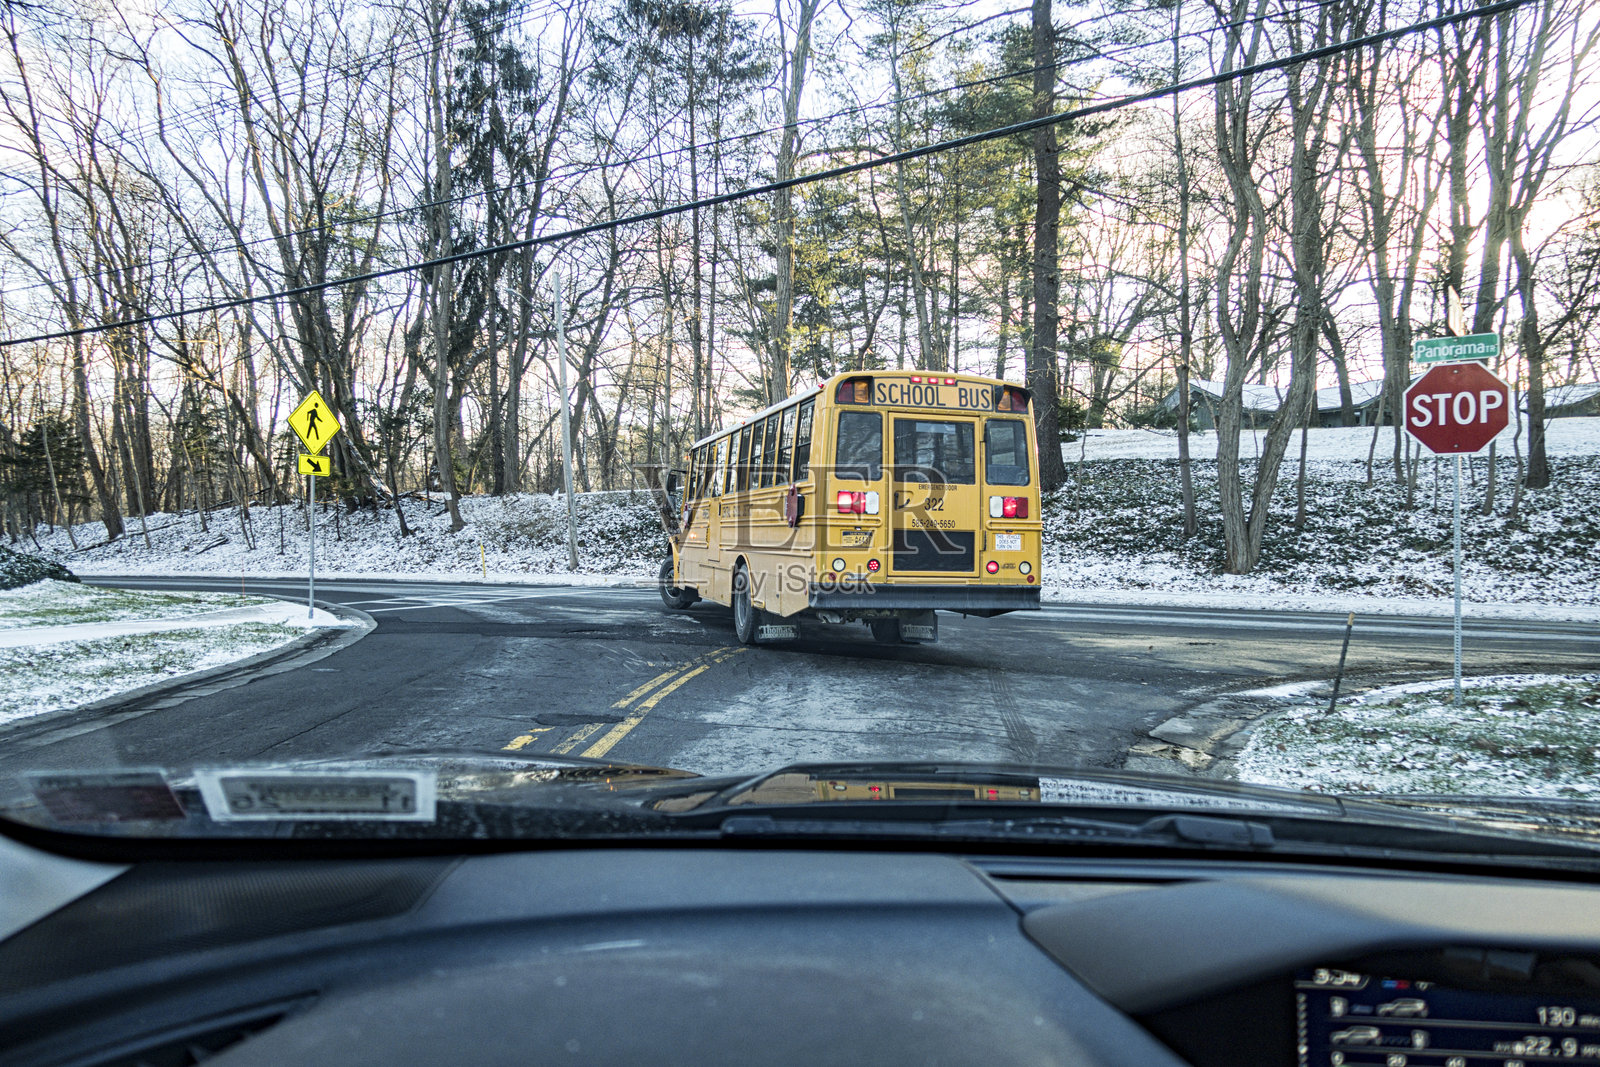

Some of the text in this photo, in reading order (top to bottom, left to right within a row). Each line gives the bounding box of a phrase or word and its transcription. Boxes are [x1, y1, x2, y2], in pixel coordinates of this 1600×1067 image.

[1417, 343, 1485, 358] Panorama
[876, 382, 991, 408] SCHOOL BUS
[1411, 390, 1503, 427] STOP
[924, 498, 944, 511] 322
[761, 624, 795, 634] Thomas
[1538, 1006, 1576, 1027] 130
